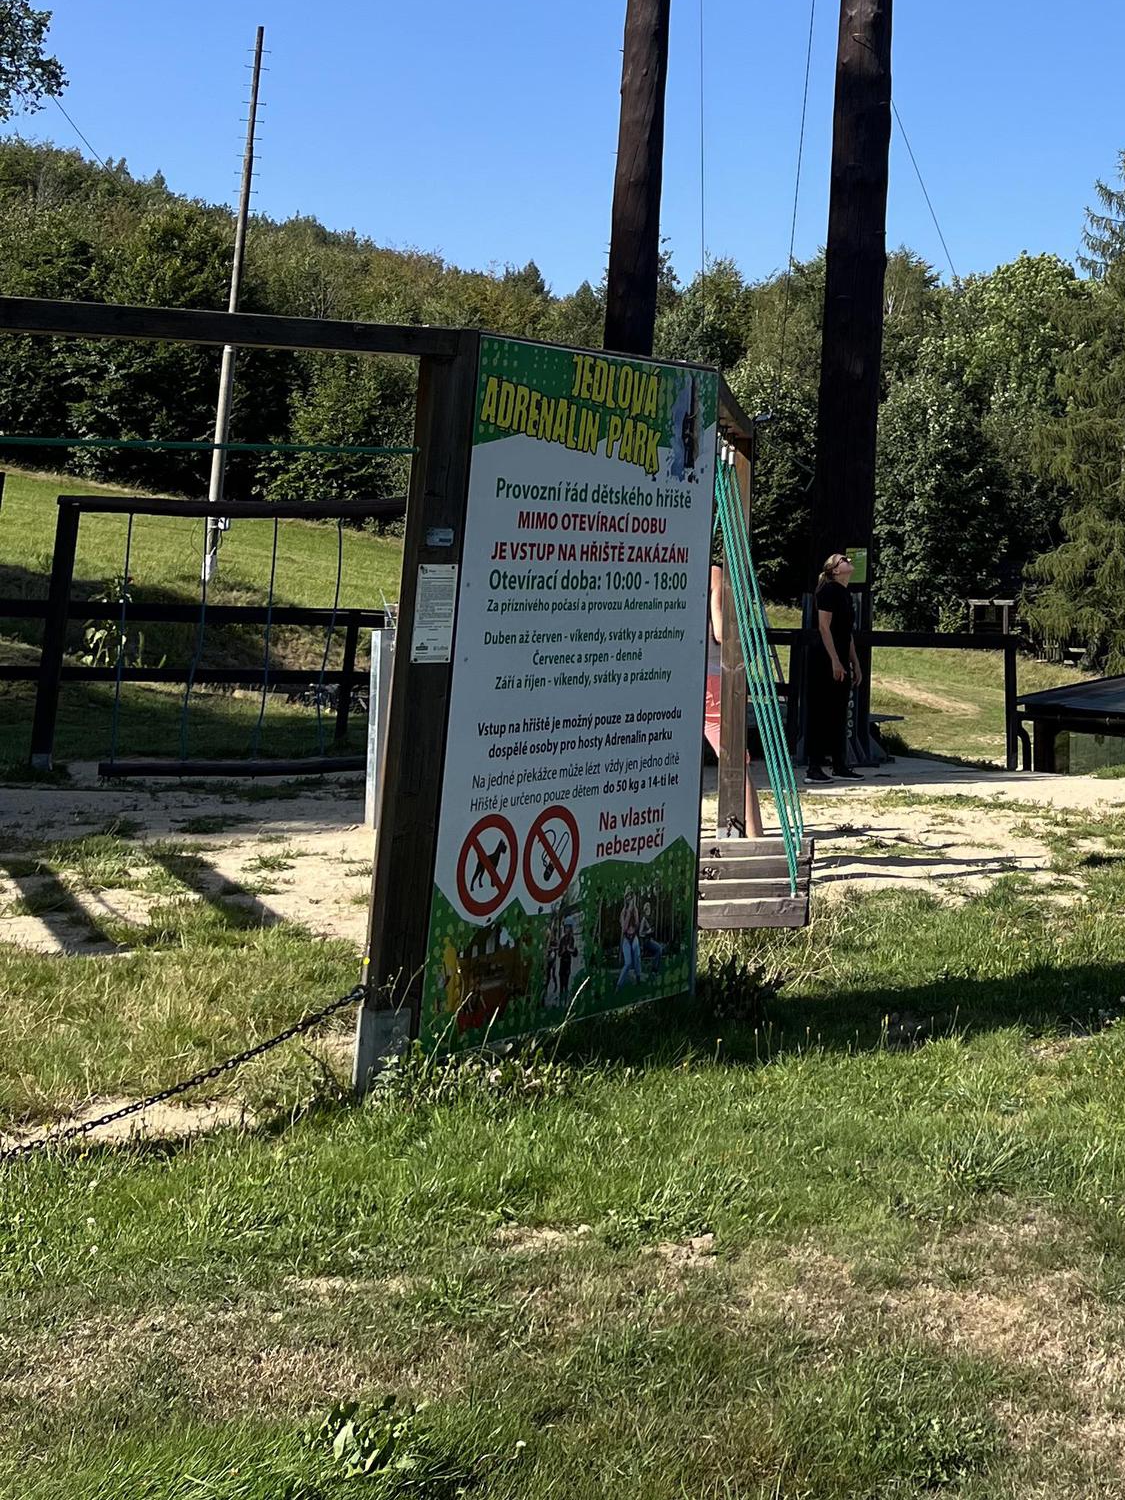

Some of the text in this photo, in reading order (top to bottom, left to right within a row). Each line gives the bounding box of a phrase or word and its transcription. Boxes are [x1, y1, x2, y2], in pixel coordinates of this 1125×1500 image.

[572, 354, 660, 419] JEDLOVÁ
[480, 376, 662, 476] ADRENALIN PARK
[496, 478, 691, 508] Provozní řád dětského hřiště
[518, 511, 667, 534] MIMO OTEVÍRACÍ DOBU
[491, 541, 689, 563] JE VSTUP NA HŘIŠTĚ ZAKÁZÁN!
[489, 569, 558, 590] Otevírací
[561, 570, 601, 590] doba:
[606, 571, 641, 590] 10:00
[654, 572, 687, 590] 18:00
[487, 598, 686, 614] Za příznivého počasí a provozu Adrenalin parku
[484, 631, 516, 645] Duben
[519, 631, 530, 644] až
[532, 631, 562, 644] červen
[570, 628, 607, 644] víkendy,
[609, 628, 636, 643] svátky
[638, 631, 642, 639] a
[645, 627, 685, 642] prázdniny
[533, 650, 575, 665] Červenec
[577, 655, 582, 663] a
[584, 652, 609, 665] srpen
[616, 648, 642, 661] denně
[495, 675, 515, 690] Září
[517, 680, 522, 688] a
[524, 676, 546, 691] říjen
[554, 672, 591, 688] víkendy,
[593, 670, 621, 685] svátky
[623, 673, 628, 682] a
[630, 668, 672, 685] prázdniny
[478, 706, 682, 738] Vstup na hřiště je možný pouze za doprovodu
[489, 728, 673, 760] dospělé osoby pro hosty Adrenalin parku
[472, 751, 680, 791] Na jedné překážce může lézt vždy jen jedno dítě
[470, 773, 679, 812] Hřiště je určeno pouze dětem do 50 kg a 14-ti let
[599, 802, 665, 832] Na vlastní
[597, 828, 665, 858] nebezpečí
